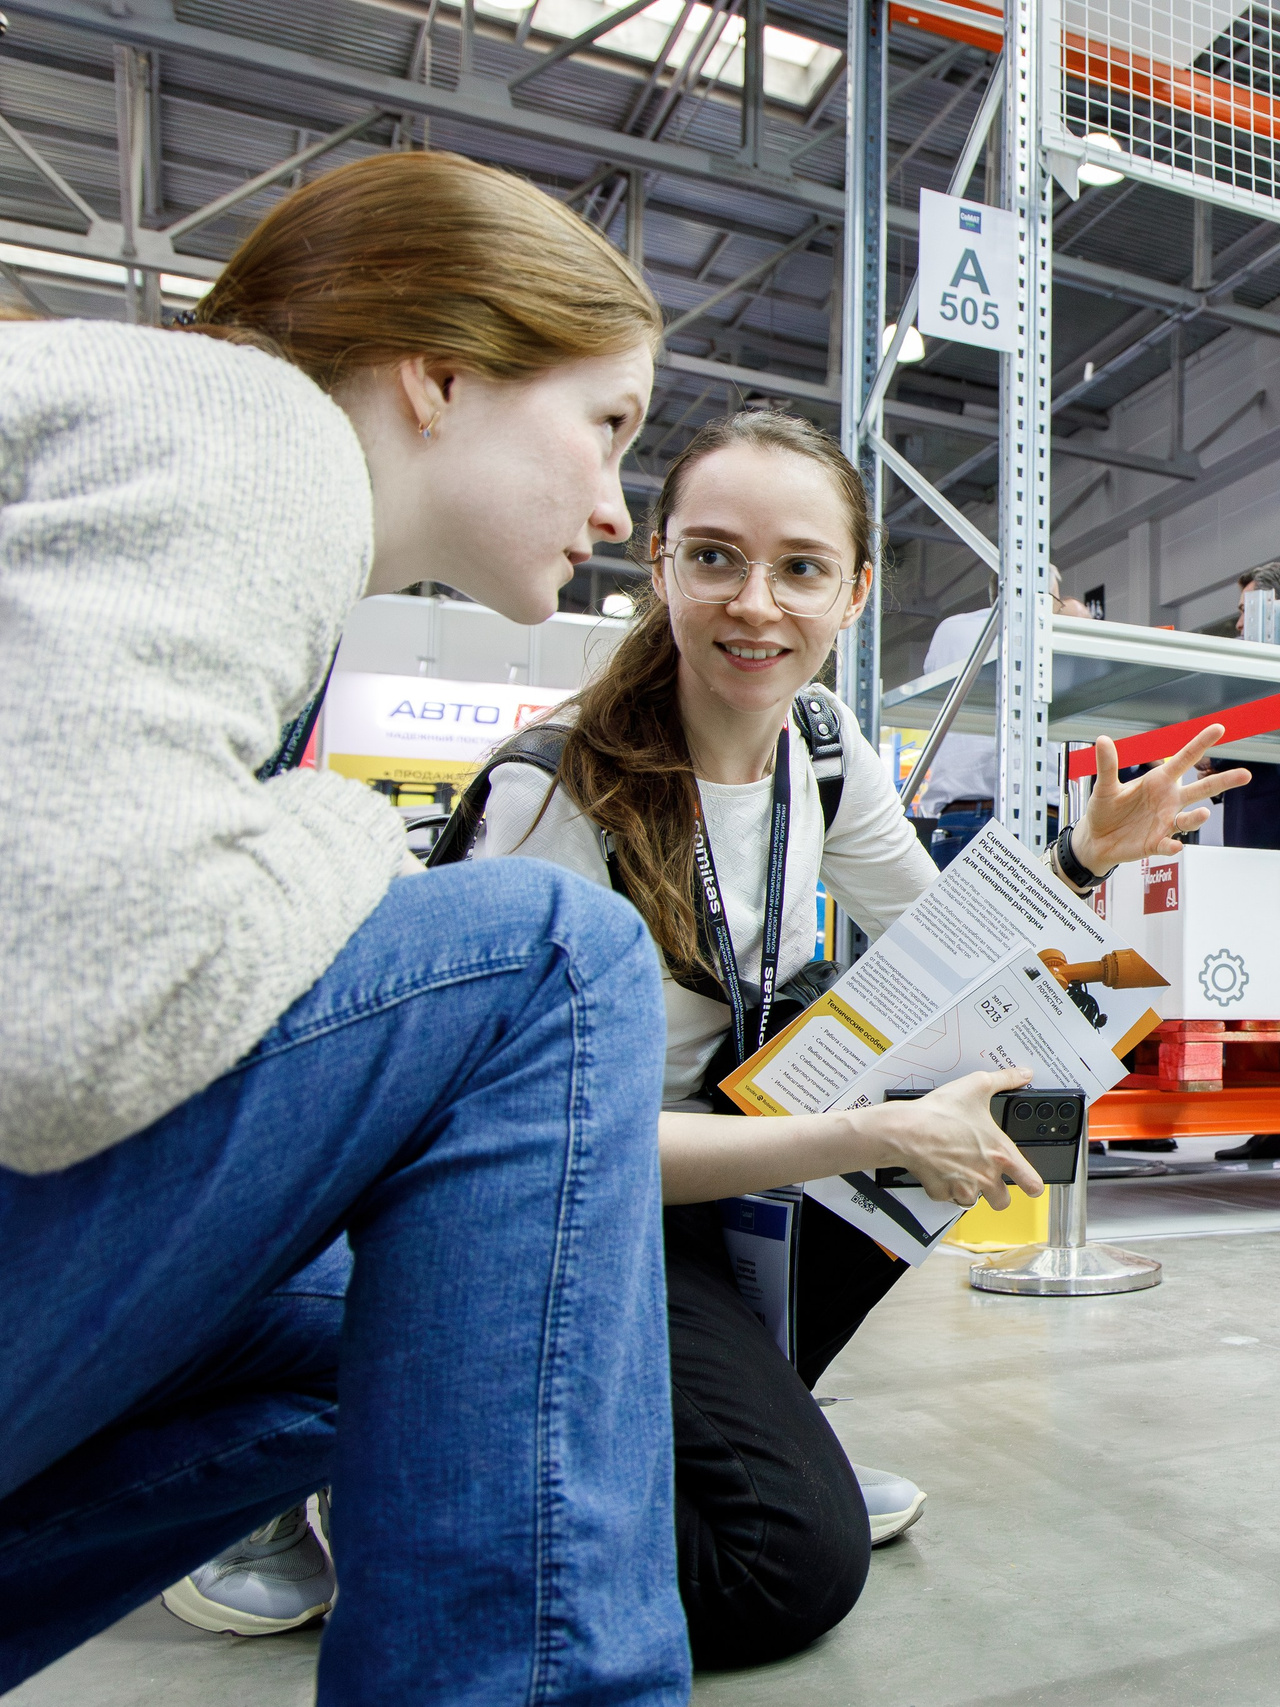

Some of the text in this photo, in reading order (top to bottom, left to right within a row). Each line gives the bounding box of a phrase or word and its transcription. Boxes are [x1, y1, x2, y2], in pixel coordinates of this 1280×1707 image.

[949, 248, 990, 296] A
[939, 291, 999, 330] 505
[389, 700, 500, 725] АВТО
[940, 886, 963, 906] складской
[946, 873, 966, 892] объектов
[970, 895, 986, 910] одного
[985, 908, 998, 921] места
[962, 855, 1043, 930] для сценариев растарки
[976, 851, 1019, 893] техническим
[1018, 891, 1047, 919] зрением
[978, 838, 1076, 931] Pick-and-Place: депалетизация
[986, 831, 1104, 943] Сценарий использования технологии
[913, 914, 922, 923] без
[920, 921, 938, 938] участия
[923, 897, 933, 906] для
[931, 904, 957, 928] реализации
[955, 926, 978, 947] различных
[928, 892, 986, 945] Яндекс Роботикс разработал
[942, 877, 951, 887] Это
[950, 885, 961, 896] одна
[965, 899, 979, 913] самых
[978, 911, 998, 930] массовых
[997, 929, 1010, 941] задач
[983, 898, 1004, 917] операция
[1007, 920, 1036, 948] перемещению
[914, 907, 944, 934] перемещения
[955, 943, 971, 959] быстро
[919, 902, 979, 957] которые позволяют выполнять
[863, 961, 873, 969] для
[873, 950, 930, 1001] Роботизированная система
[874, 960, 891, 976] Яндекс
[889, 973, 910, 992] Роботикс
[845, 980, 866, 999] объектов
[868, 1000, 887, 1017] высокой
[850, 975, 873, 996] выполнять
[872, 995, 894, 1014] операции
[855, 970, 880, 993] машинного
[878, 991, 895, 1006] зрения
[859, 965, 879, 984] Решение
[878, 981, 903, 1004] базируется
[1036, 984, 1062, 1015] логистика
[1041, 980, 1063, 1005] аметист
[757, 965, 774, 1050] omitas
[826, 998, 864, 1033] Технические
[980, 999, 1001, 1022] D213
[991, 994, 1012, 1013] зал 4
[807, 1045, 822, 1060] Выбор
[815, 1037, 834, 1055] Система
[823, 1028, 839, 1044] Работа
[841, 1045, 860, 1062] грузами
[988, 1051, 999, 1064] как
[995, 1044, 1007, 1057] Все
[790, 1062, 826, 1093] Круглосуточная
[799, 1054, 825, 1077] Стабильная
[774, 1079, 801, 1103] Интеграция
